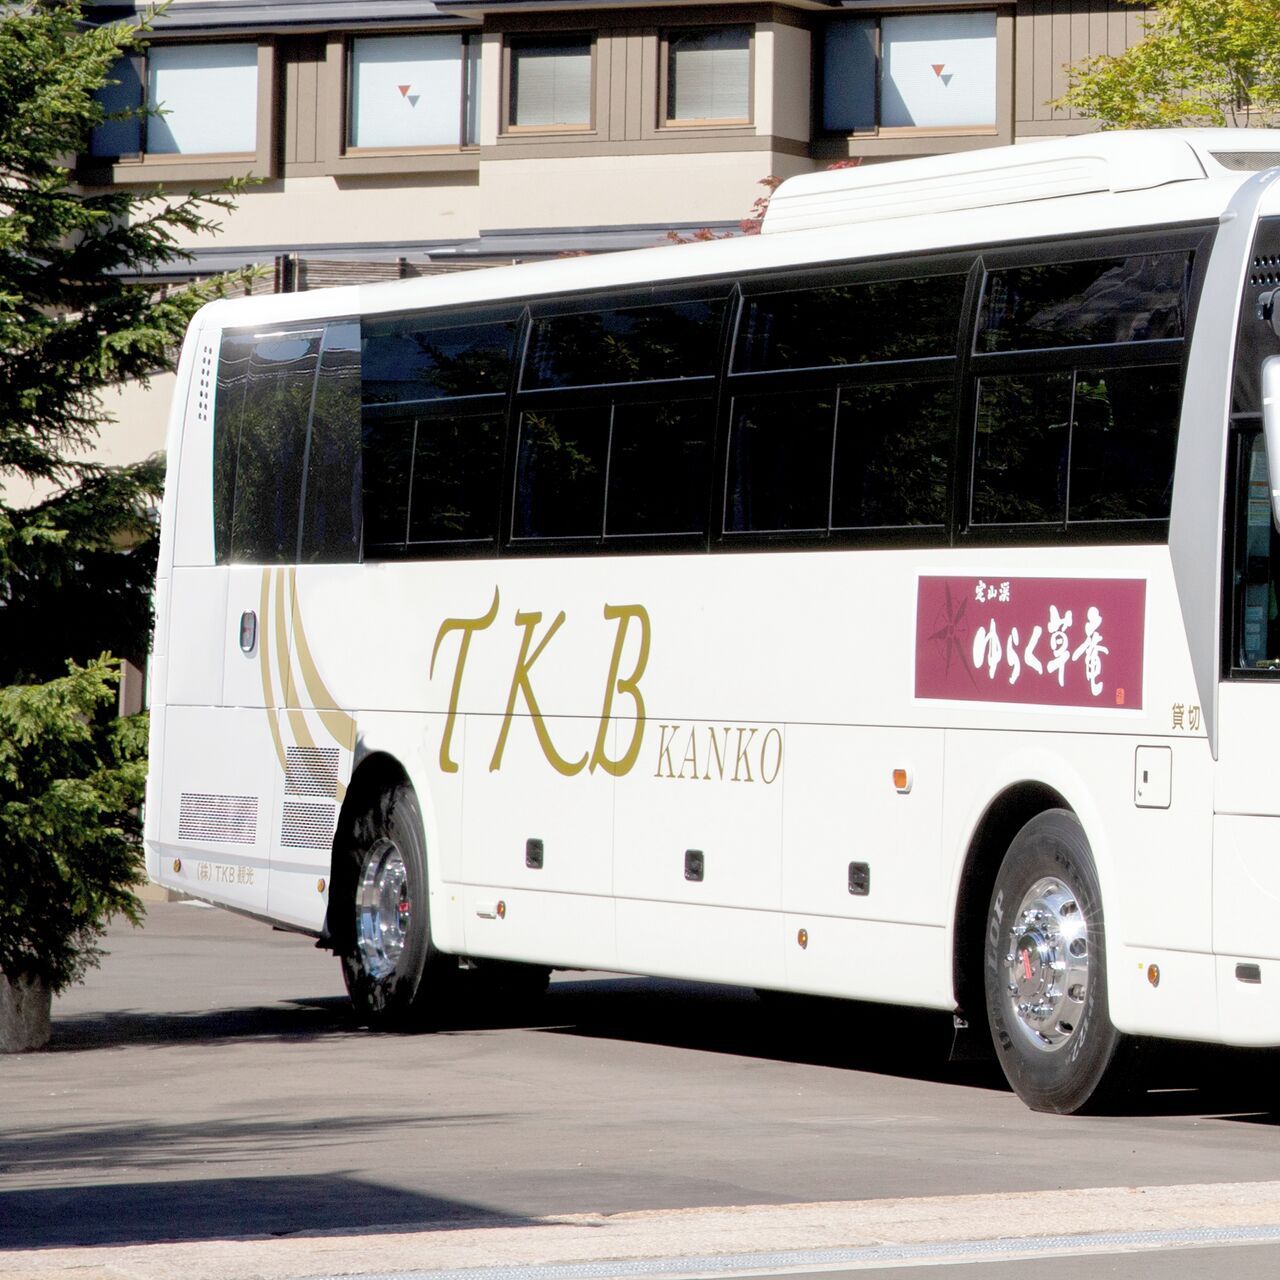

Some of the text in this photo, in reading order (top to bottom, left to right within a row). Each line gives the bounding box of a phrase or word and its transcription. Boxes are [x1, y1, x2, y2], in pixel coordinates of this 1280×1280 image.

[429, 584, 783, 784] TKB KANKO
[972, 604, 1109, 696] ゆらく草庵
[215, 865, 235, 883] TKB
